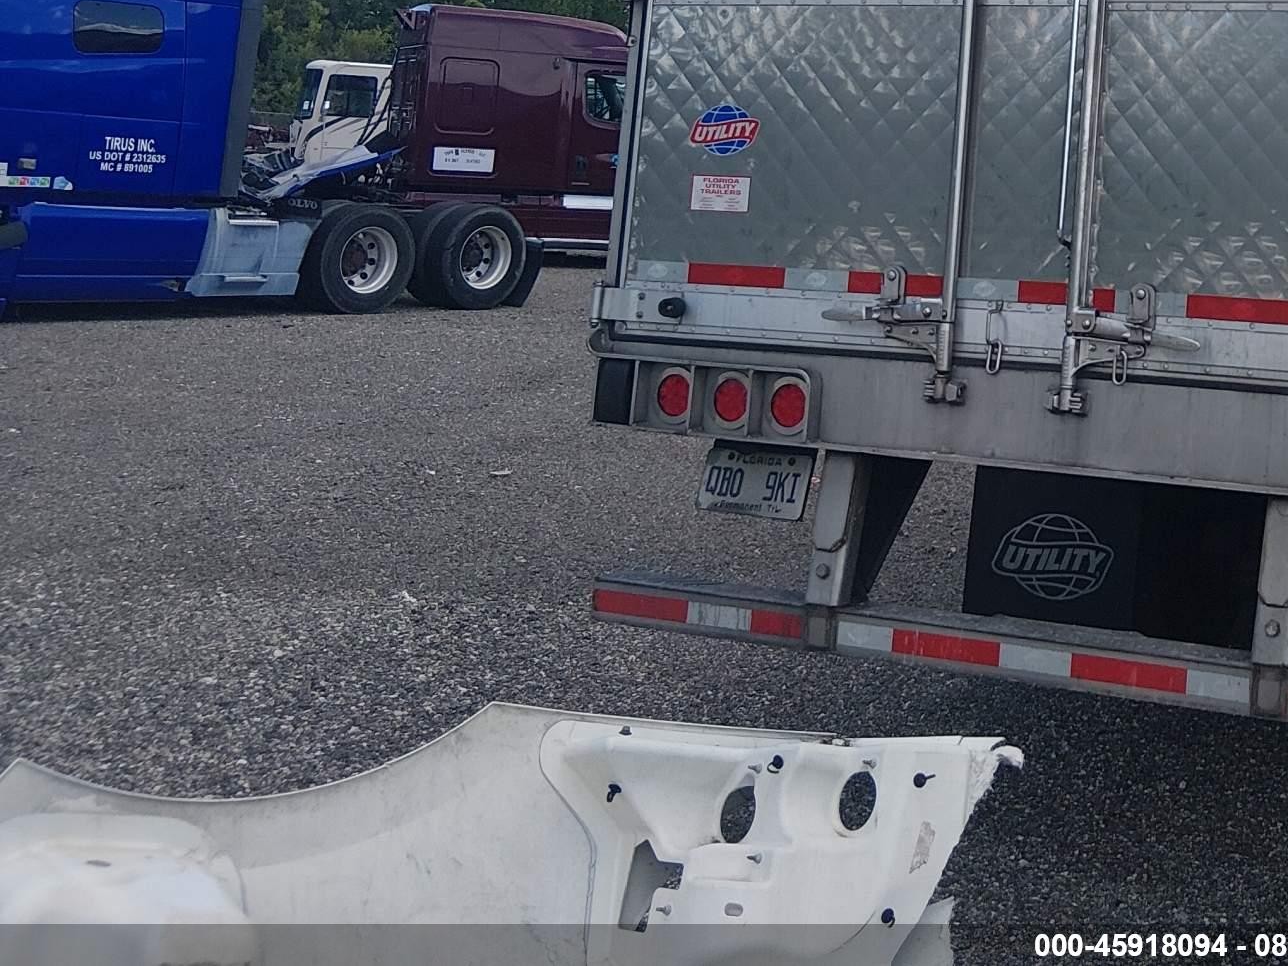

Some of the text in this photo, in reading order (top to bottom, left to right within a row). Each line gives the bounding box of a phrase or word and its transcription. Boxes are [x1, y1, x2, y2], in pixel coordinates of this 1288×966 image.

[694, 122, 756, 142] UTILITY
[105, 136, 156, 153] TIRUS INC.
[89, 151, 166, 164] US DOT # 2312635
[100, 162, 114, 172] MC
[116, 162, 122, 172] #
[1002, 544, 1107, 574] UTILITY
